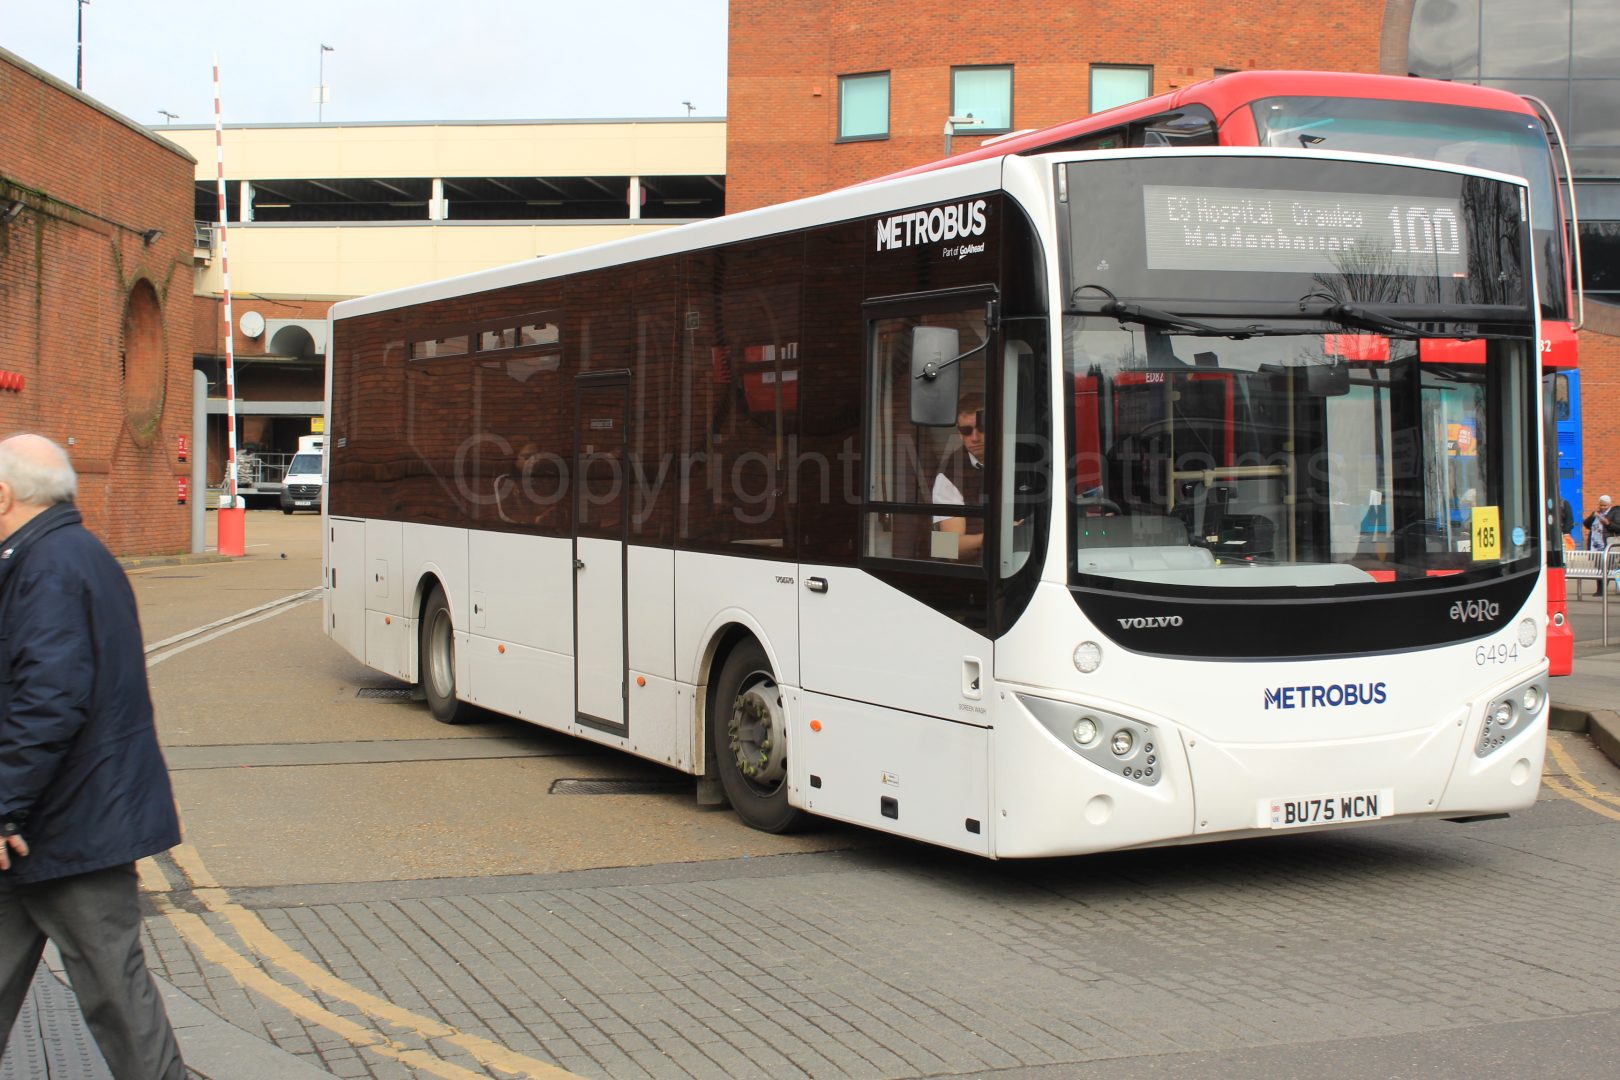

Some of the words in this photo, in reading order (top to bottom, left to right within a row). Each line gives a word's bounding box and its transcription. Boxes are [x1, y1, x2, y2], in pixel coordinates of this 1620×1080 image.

[876, 199, 987, 251] METROBUS
[1196, 197, 1273, 225] Hospital
[1292, 202, 1364, 228] Crawley
[1183, 224, 1355, 251] Maidenbower
[1387, 205, 1460, 254] 100
[942, 247, 953, 257] Part
[1476, 526, 1496, 548] 185
[1117, 614, 1184, 630] VOLVO
[1475, 641, 1520, 667] 6494
[958, 702, 974, 714] SCREEN
[1264, 681, 1387, 710] METROBUS
[1284, 798, 1335, 825] BU75
[1340, 794, 1378, 819] WCN
